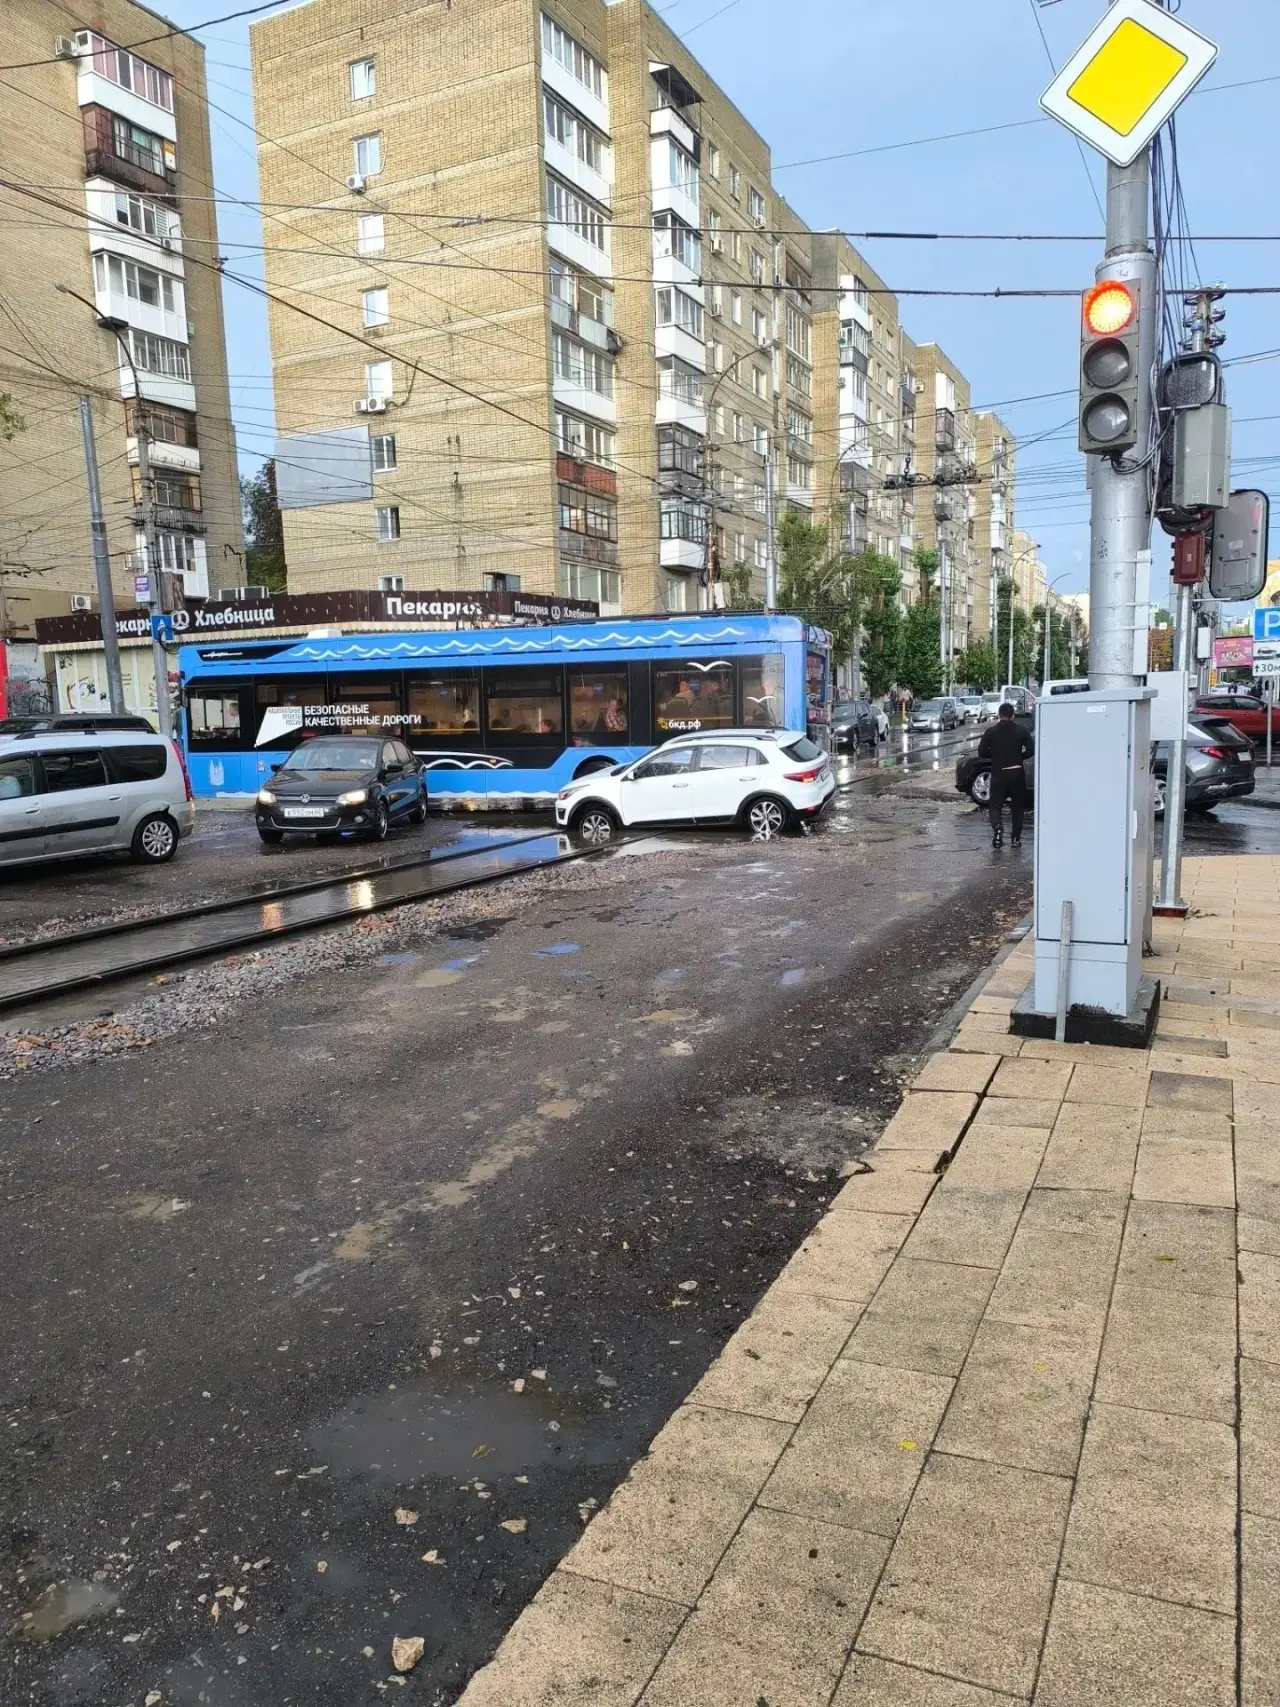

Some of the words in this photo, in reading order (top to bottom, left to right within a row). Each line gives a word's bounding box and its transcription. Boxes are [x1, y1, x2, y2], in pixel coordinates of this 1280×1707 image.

[194, 607, 274, 626] Хлебница
[304, 704, 369, 715] БЕЗОПАСНЫЕ
[305, 716, 381, 726] КАЧЕСТВЕННЫЕ
[382, 715, 422, 726] ДОРОГИ
[668, 718, 702, 730] бкд.рф
